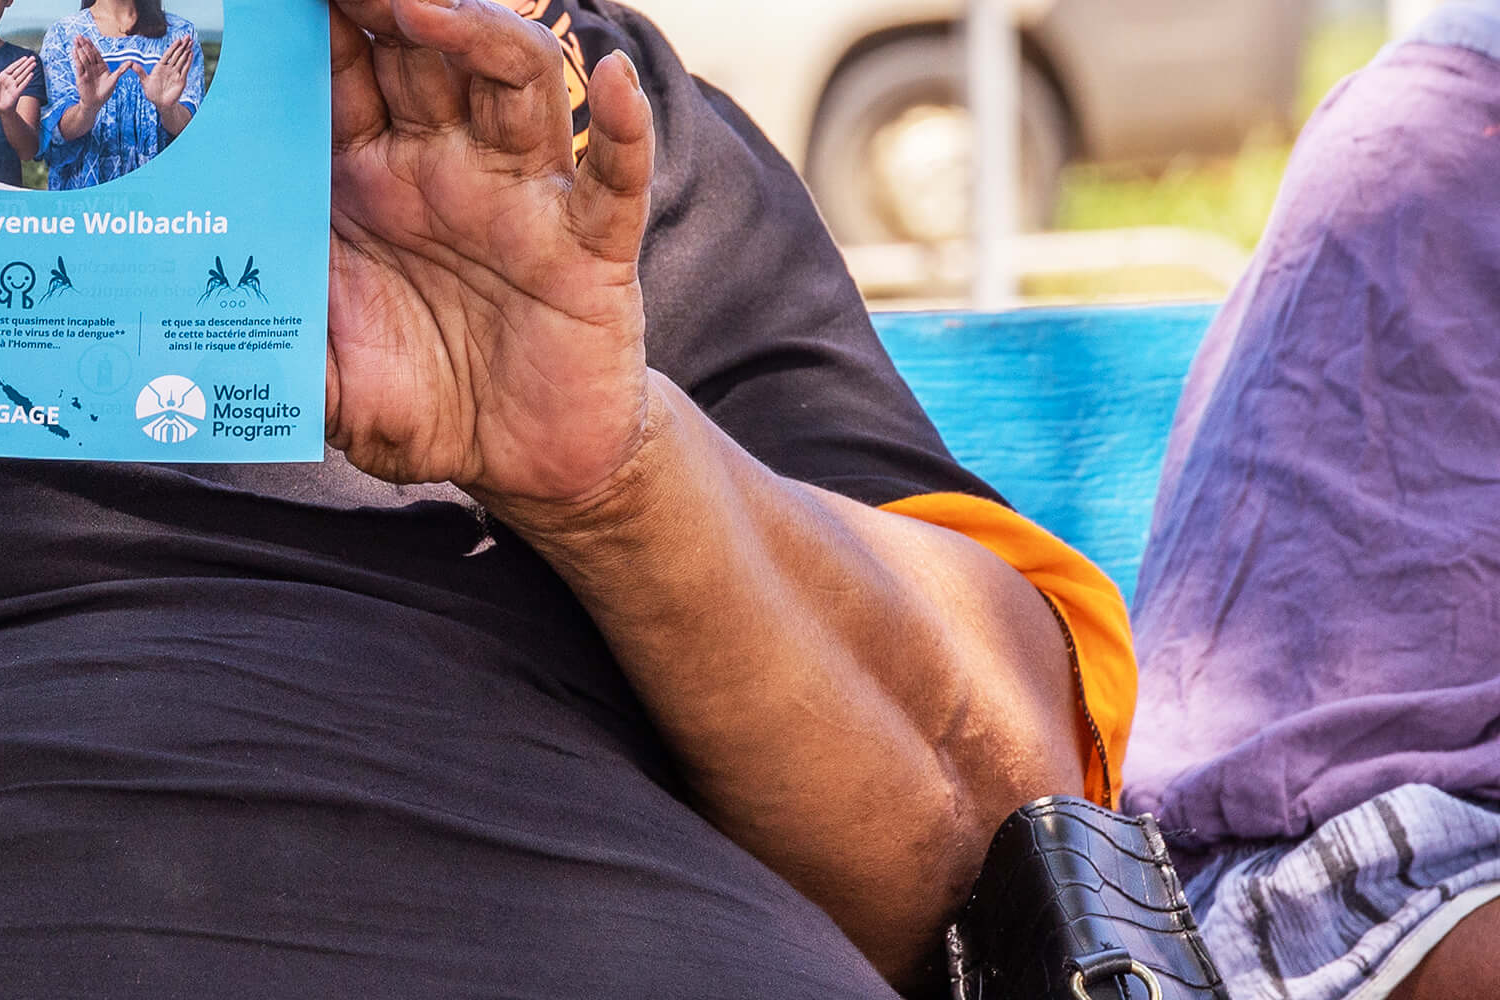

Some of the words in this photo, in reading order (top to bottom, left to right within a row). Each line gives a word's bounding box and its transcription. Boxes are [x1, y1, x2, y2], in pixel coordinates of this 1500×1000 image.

[83, 210, 228, 235] Wolbachia
[11, 316, 66, 327] quasiment
[67, 316, 116, 328] incapable
[161, 318, 173, 327] et
[175, 318, 193, 328] que
[194, 318, 206, 327] sa
[208, 316, 271, 327] descendance
[273, 315, 302, 326] hérite
[14, 328, 23, 337] le
[25, 328, 50, 337] virus
[52, 328, 64, 338] de
[66, 329, 76, 338] la
[164, 329, 177, 339] de
[179, 330, 204, 339] cette
[206, 328, 246, 339] bactérie
[248, 328, 299, 339] diminuant
[0, 339, 6, 348] à
[169, 341, 192, 351] ainsi
[194, 341, 203, 351] le
[205, 341, 235, 353] risque
[238, 339, 294, 352] d'épidémie.
[213, 384, 270, 400] World
[213, 402, 301, 423] Mosquito
